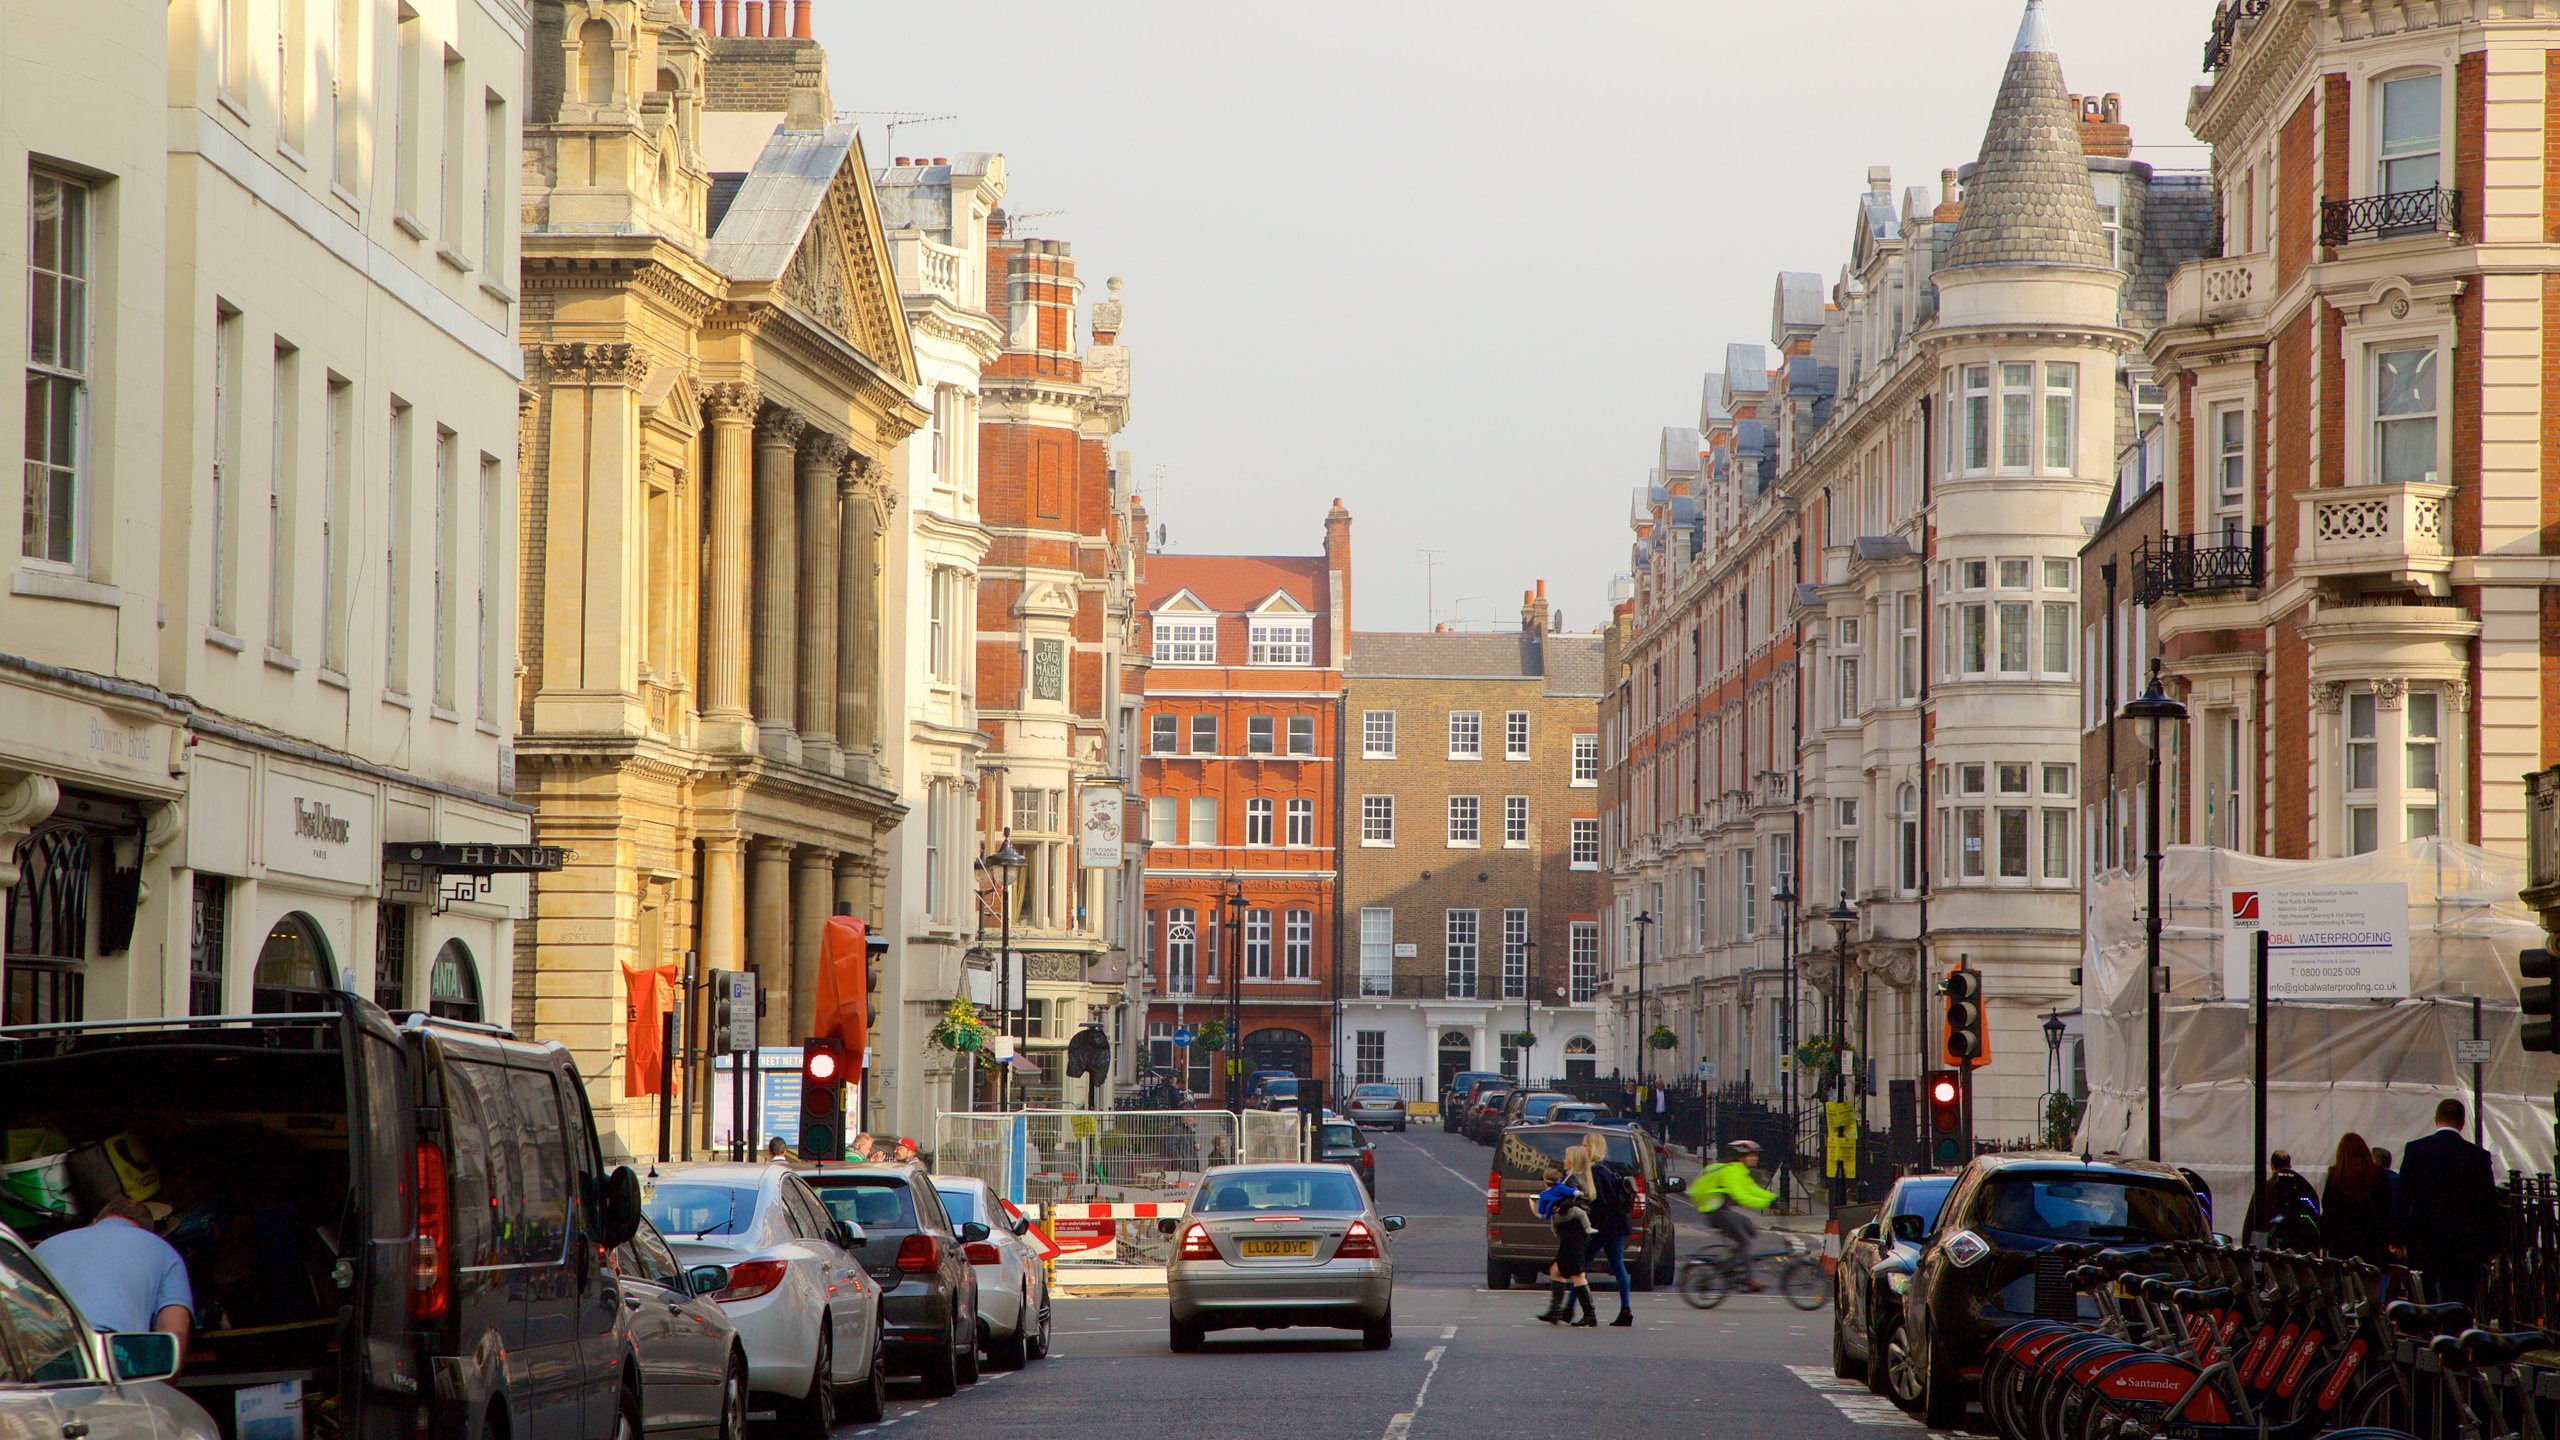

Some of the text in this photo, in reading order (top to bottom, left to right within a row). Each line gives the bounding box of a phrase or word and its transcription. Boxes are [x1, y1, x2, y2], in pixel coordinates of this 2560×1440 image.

[1042, 642, 1058, 653] THE
[1037, 676, 1059, 688] ARMS
[90, 716, 150, 761] Browns Bride
[313, 849, 327, 860] PARIS
[2234, 920, 2259, 928] swepco
[2268, 932, 2392, 945] OBAL WATERPROOFING
[2300, 967, 2321, 977] 0800
[2322, 966, 2343, 976] 0025
[2345, 966, 2361, 976] 009
[782, 1056, 804, 1066] METH
[1248, 1240, 1307, 1254] LL02 DYC
[2128, 1376, 2180, 1390] Santander
